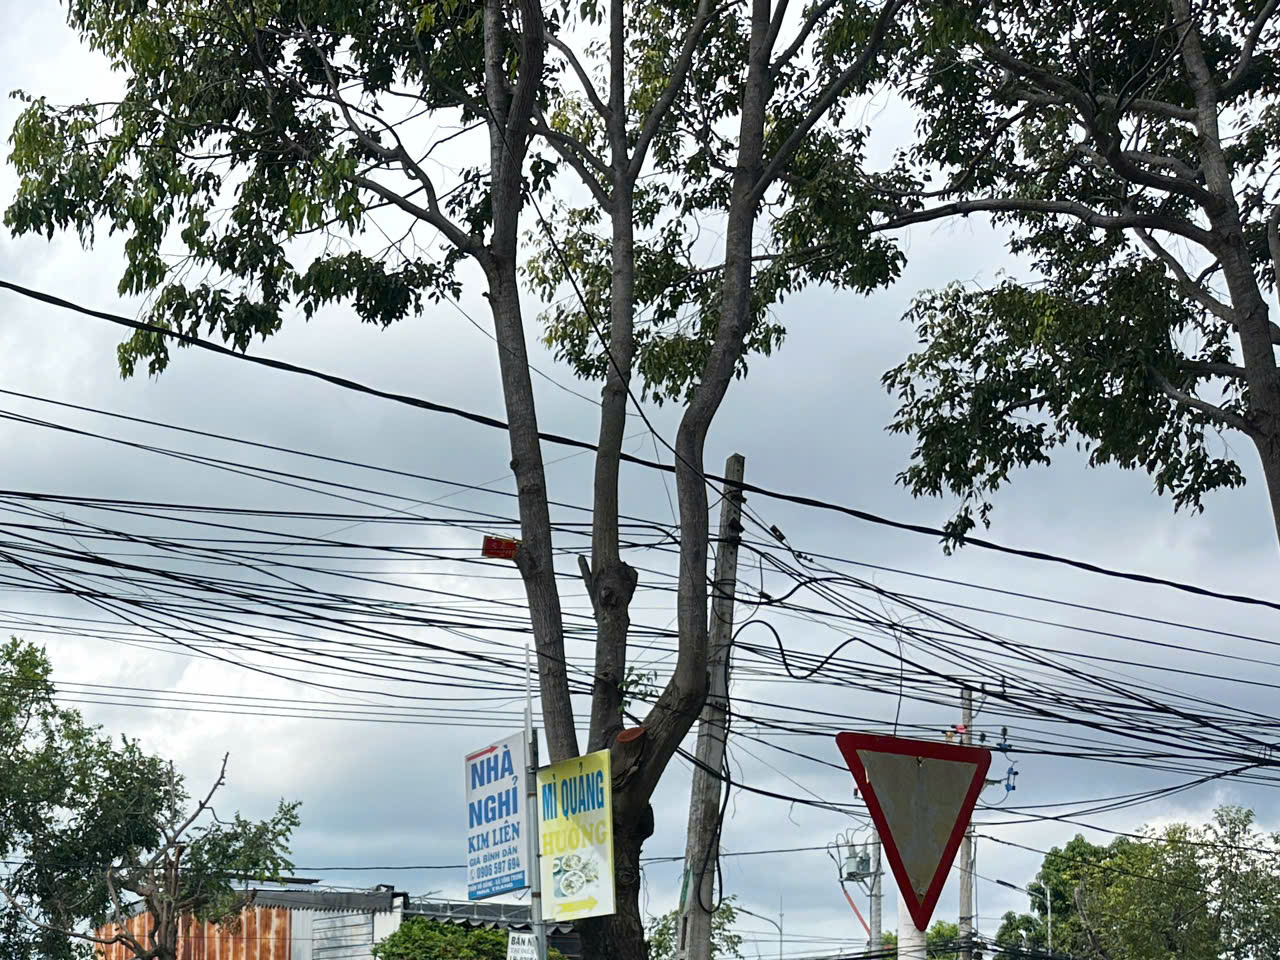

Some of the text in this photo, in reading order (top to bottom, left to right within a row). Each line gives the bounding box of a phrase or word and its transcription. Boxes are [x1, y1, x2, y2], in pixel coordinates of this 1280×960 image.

[470, 744, 514, 790] NHÀ
[542, 761, 604, 821] MÌ QUẢNG
[469, 775, 519, 829] NGHỈ
[468, 819, 520, 854] KIM LIÊN
